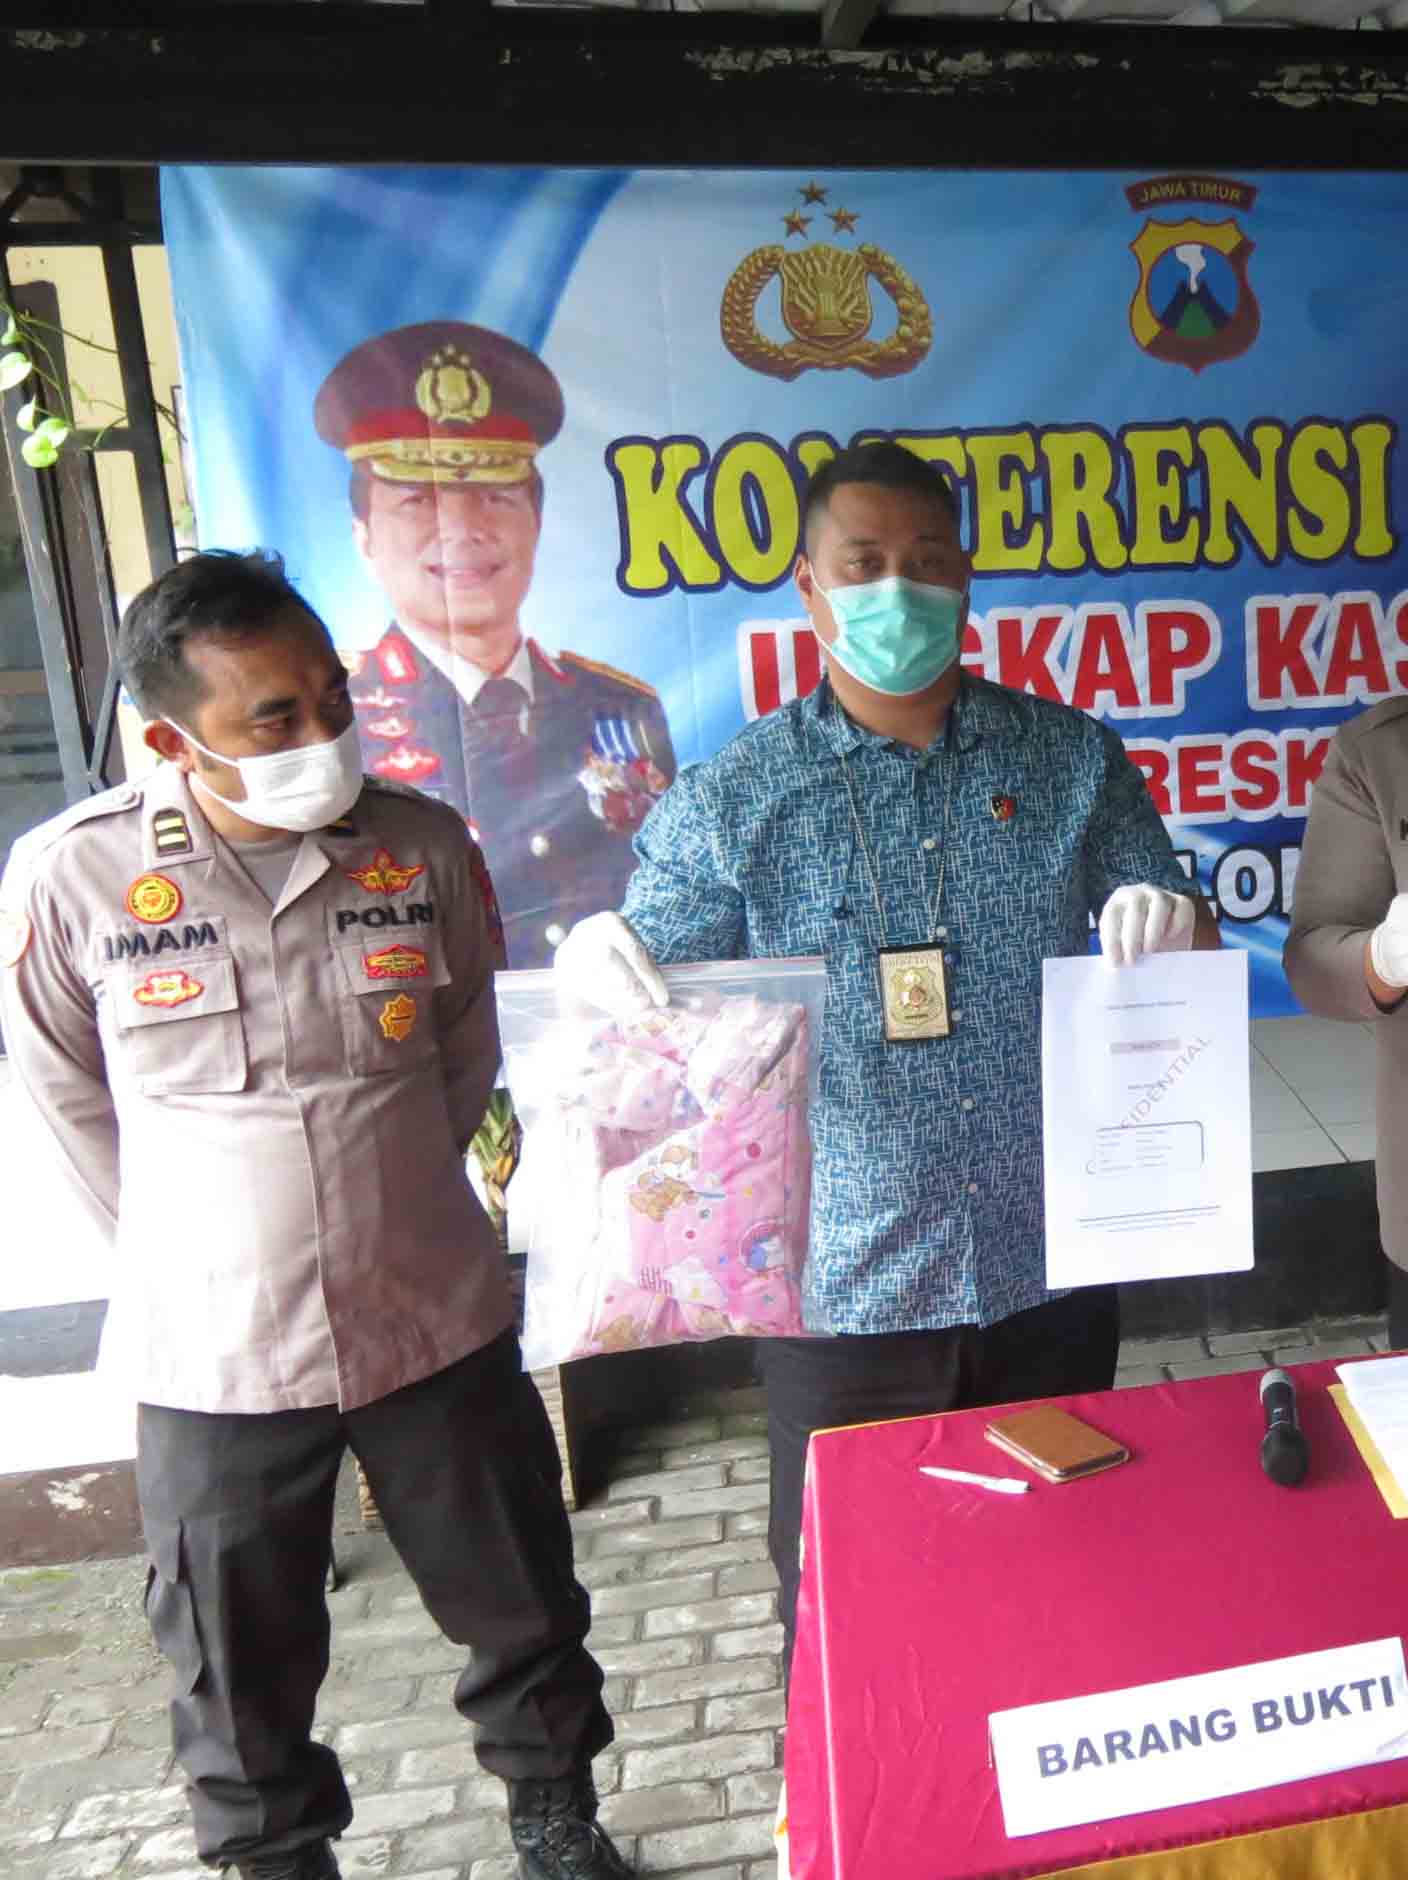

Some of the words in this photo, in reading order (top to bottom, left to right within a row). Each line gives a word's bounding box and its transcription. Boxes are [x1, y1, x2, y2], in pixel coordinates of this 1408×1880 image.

[1140, 181, 1185, 202] JAWA
[1190, 181, 1241, 201] TIMUR
[608, 418, 1396, 595] KOERENSI
[336, 901, 434, 933] POLRI
[104, 921, 219, 961] IMAM
[1036, 1708, 1237, 1778] BARANG
[1251, 1675, 1396, 1735] BUKTI
